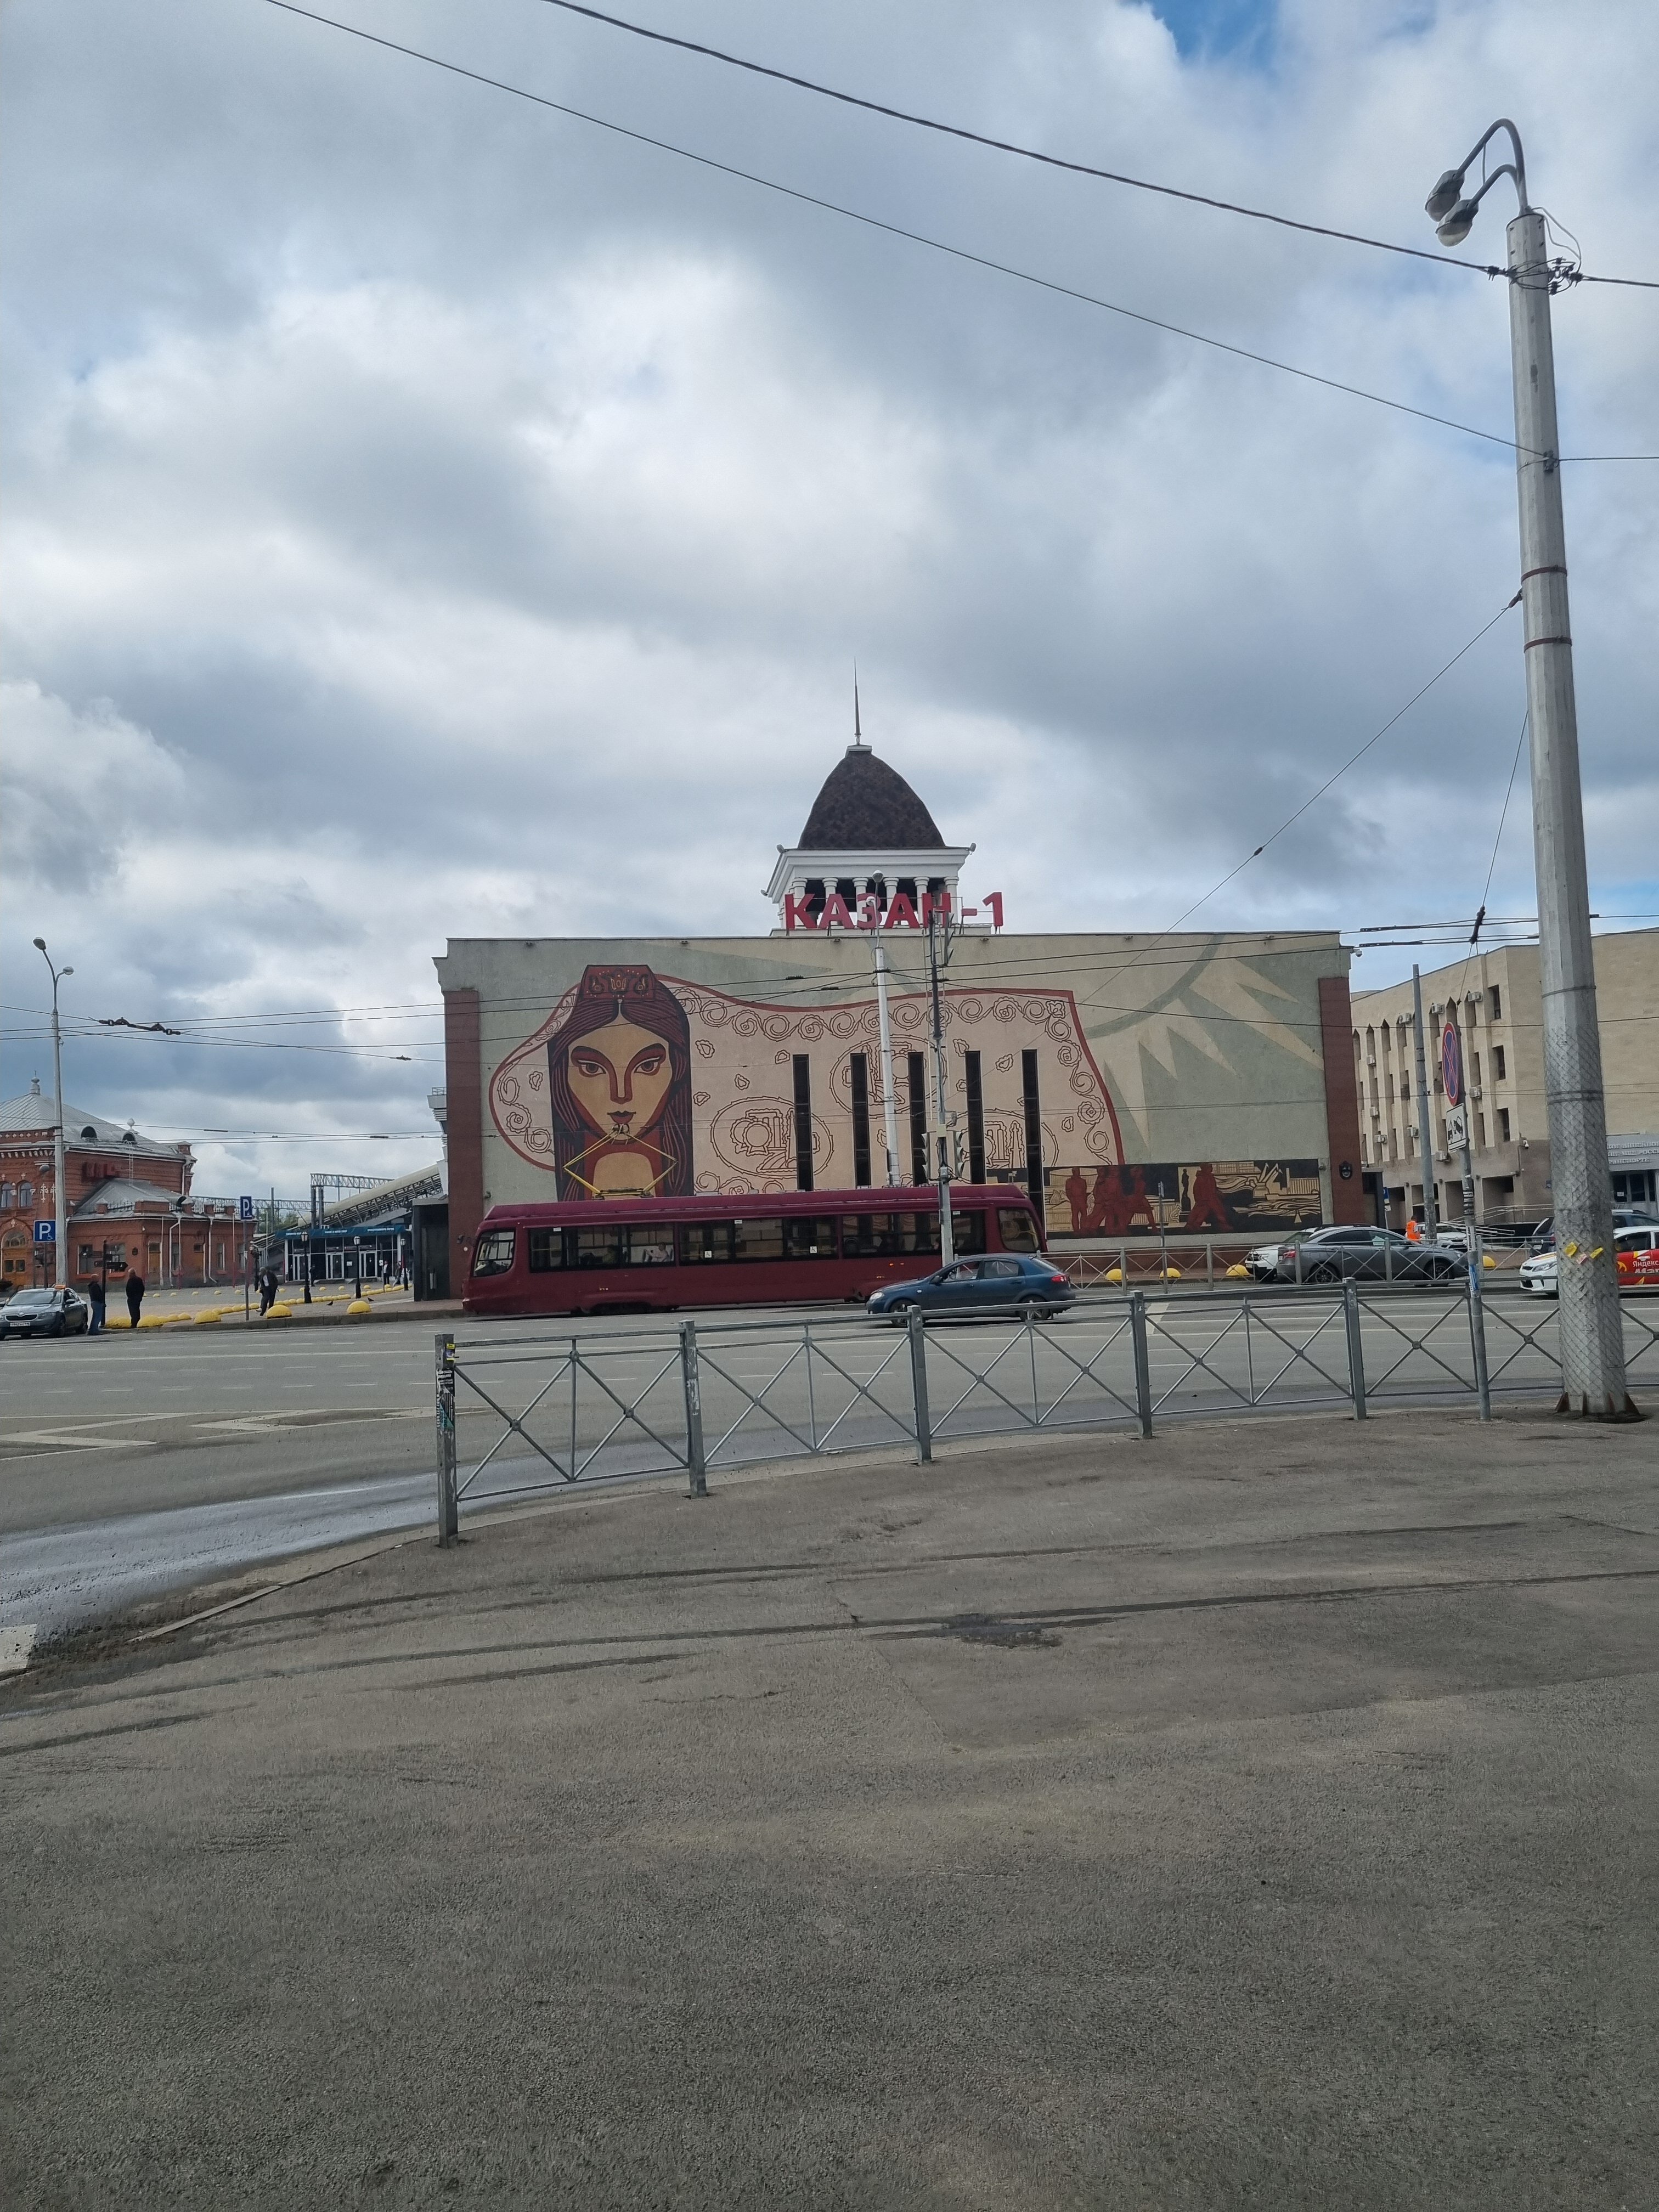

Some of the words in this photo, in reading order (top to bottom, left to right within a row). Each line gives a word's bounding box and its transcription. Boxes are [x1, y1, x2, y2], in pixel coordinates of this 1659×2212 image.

[785, 891, 1003, 930] КАЗАН-1
[242, 1199, 250, 1218] P
[39, 1222, 52, 1240] P
